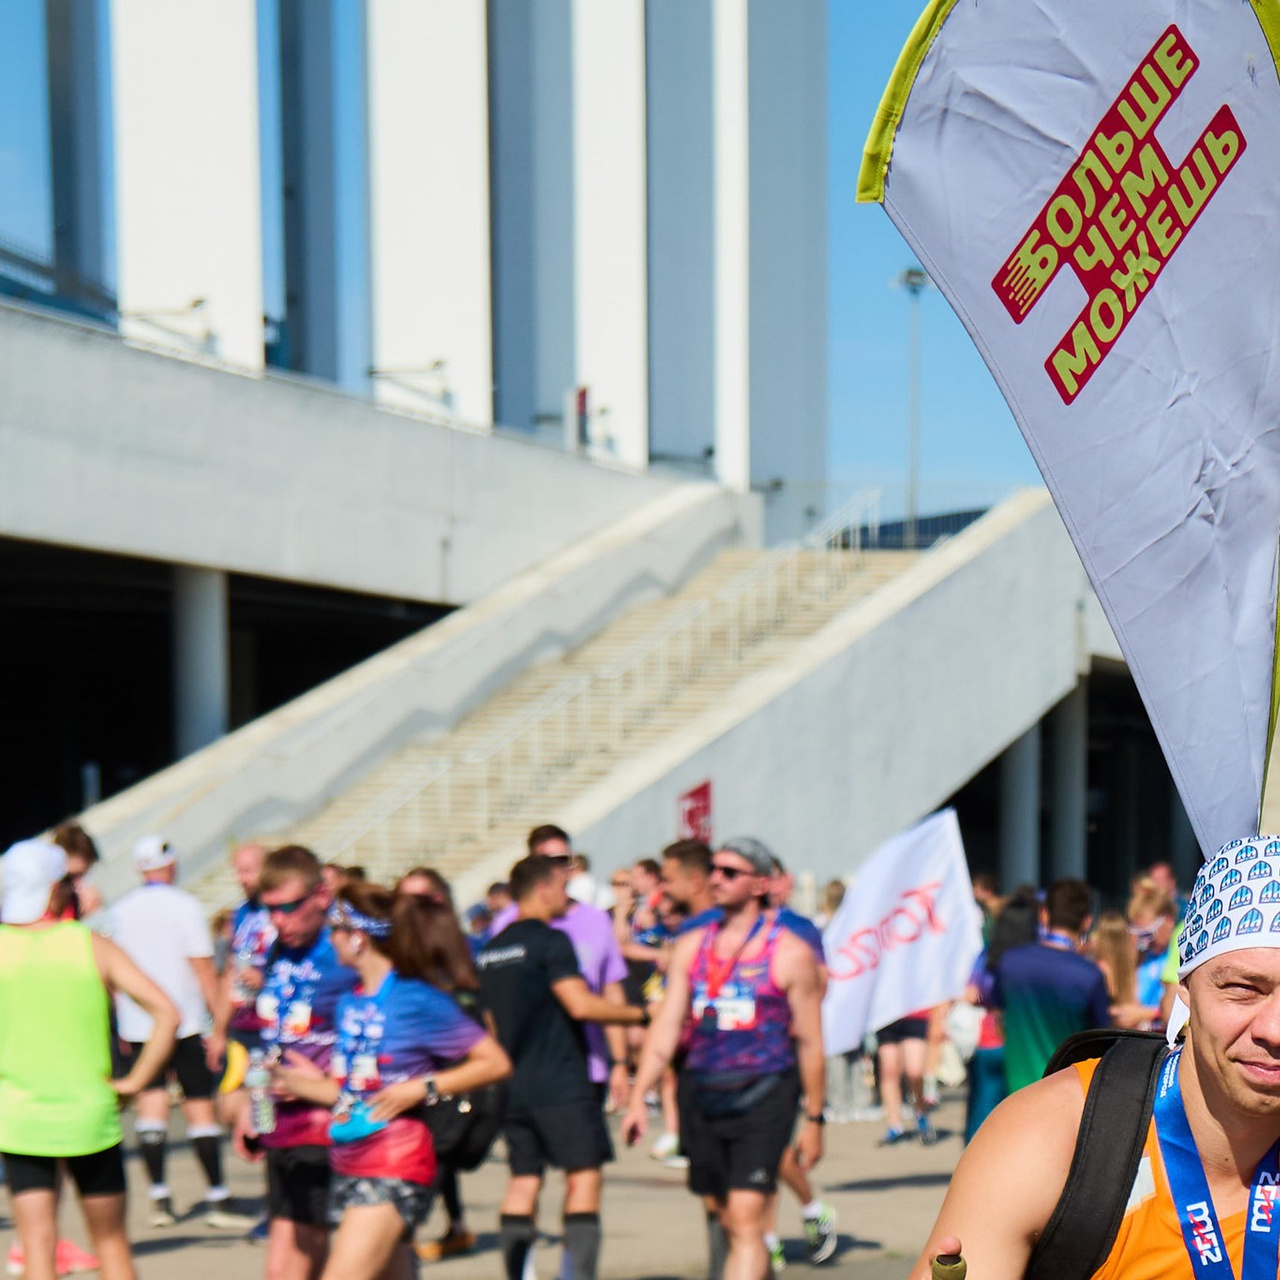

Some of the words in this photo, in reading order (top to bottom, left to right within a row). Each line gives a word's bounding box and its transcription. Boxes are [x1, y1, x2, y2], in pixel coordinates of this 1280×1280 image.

[1003, 33, 1194, 315] БОЛЬШЕ
[1051, 129, 1239, 396] МОЖЕШЬ
[1073, 142, 1169, 271] ЧЕМ
